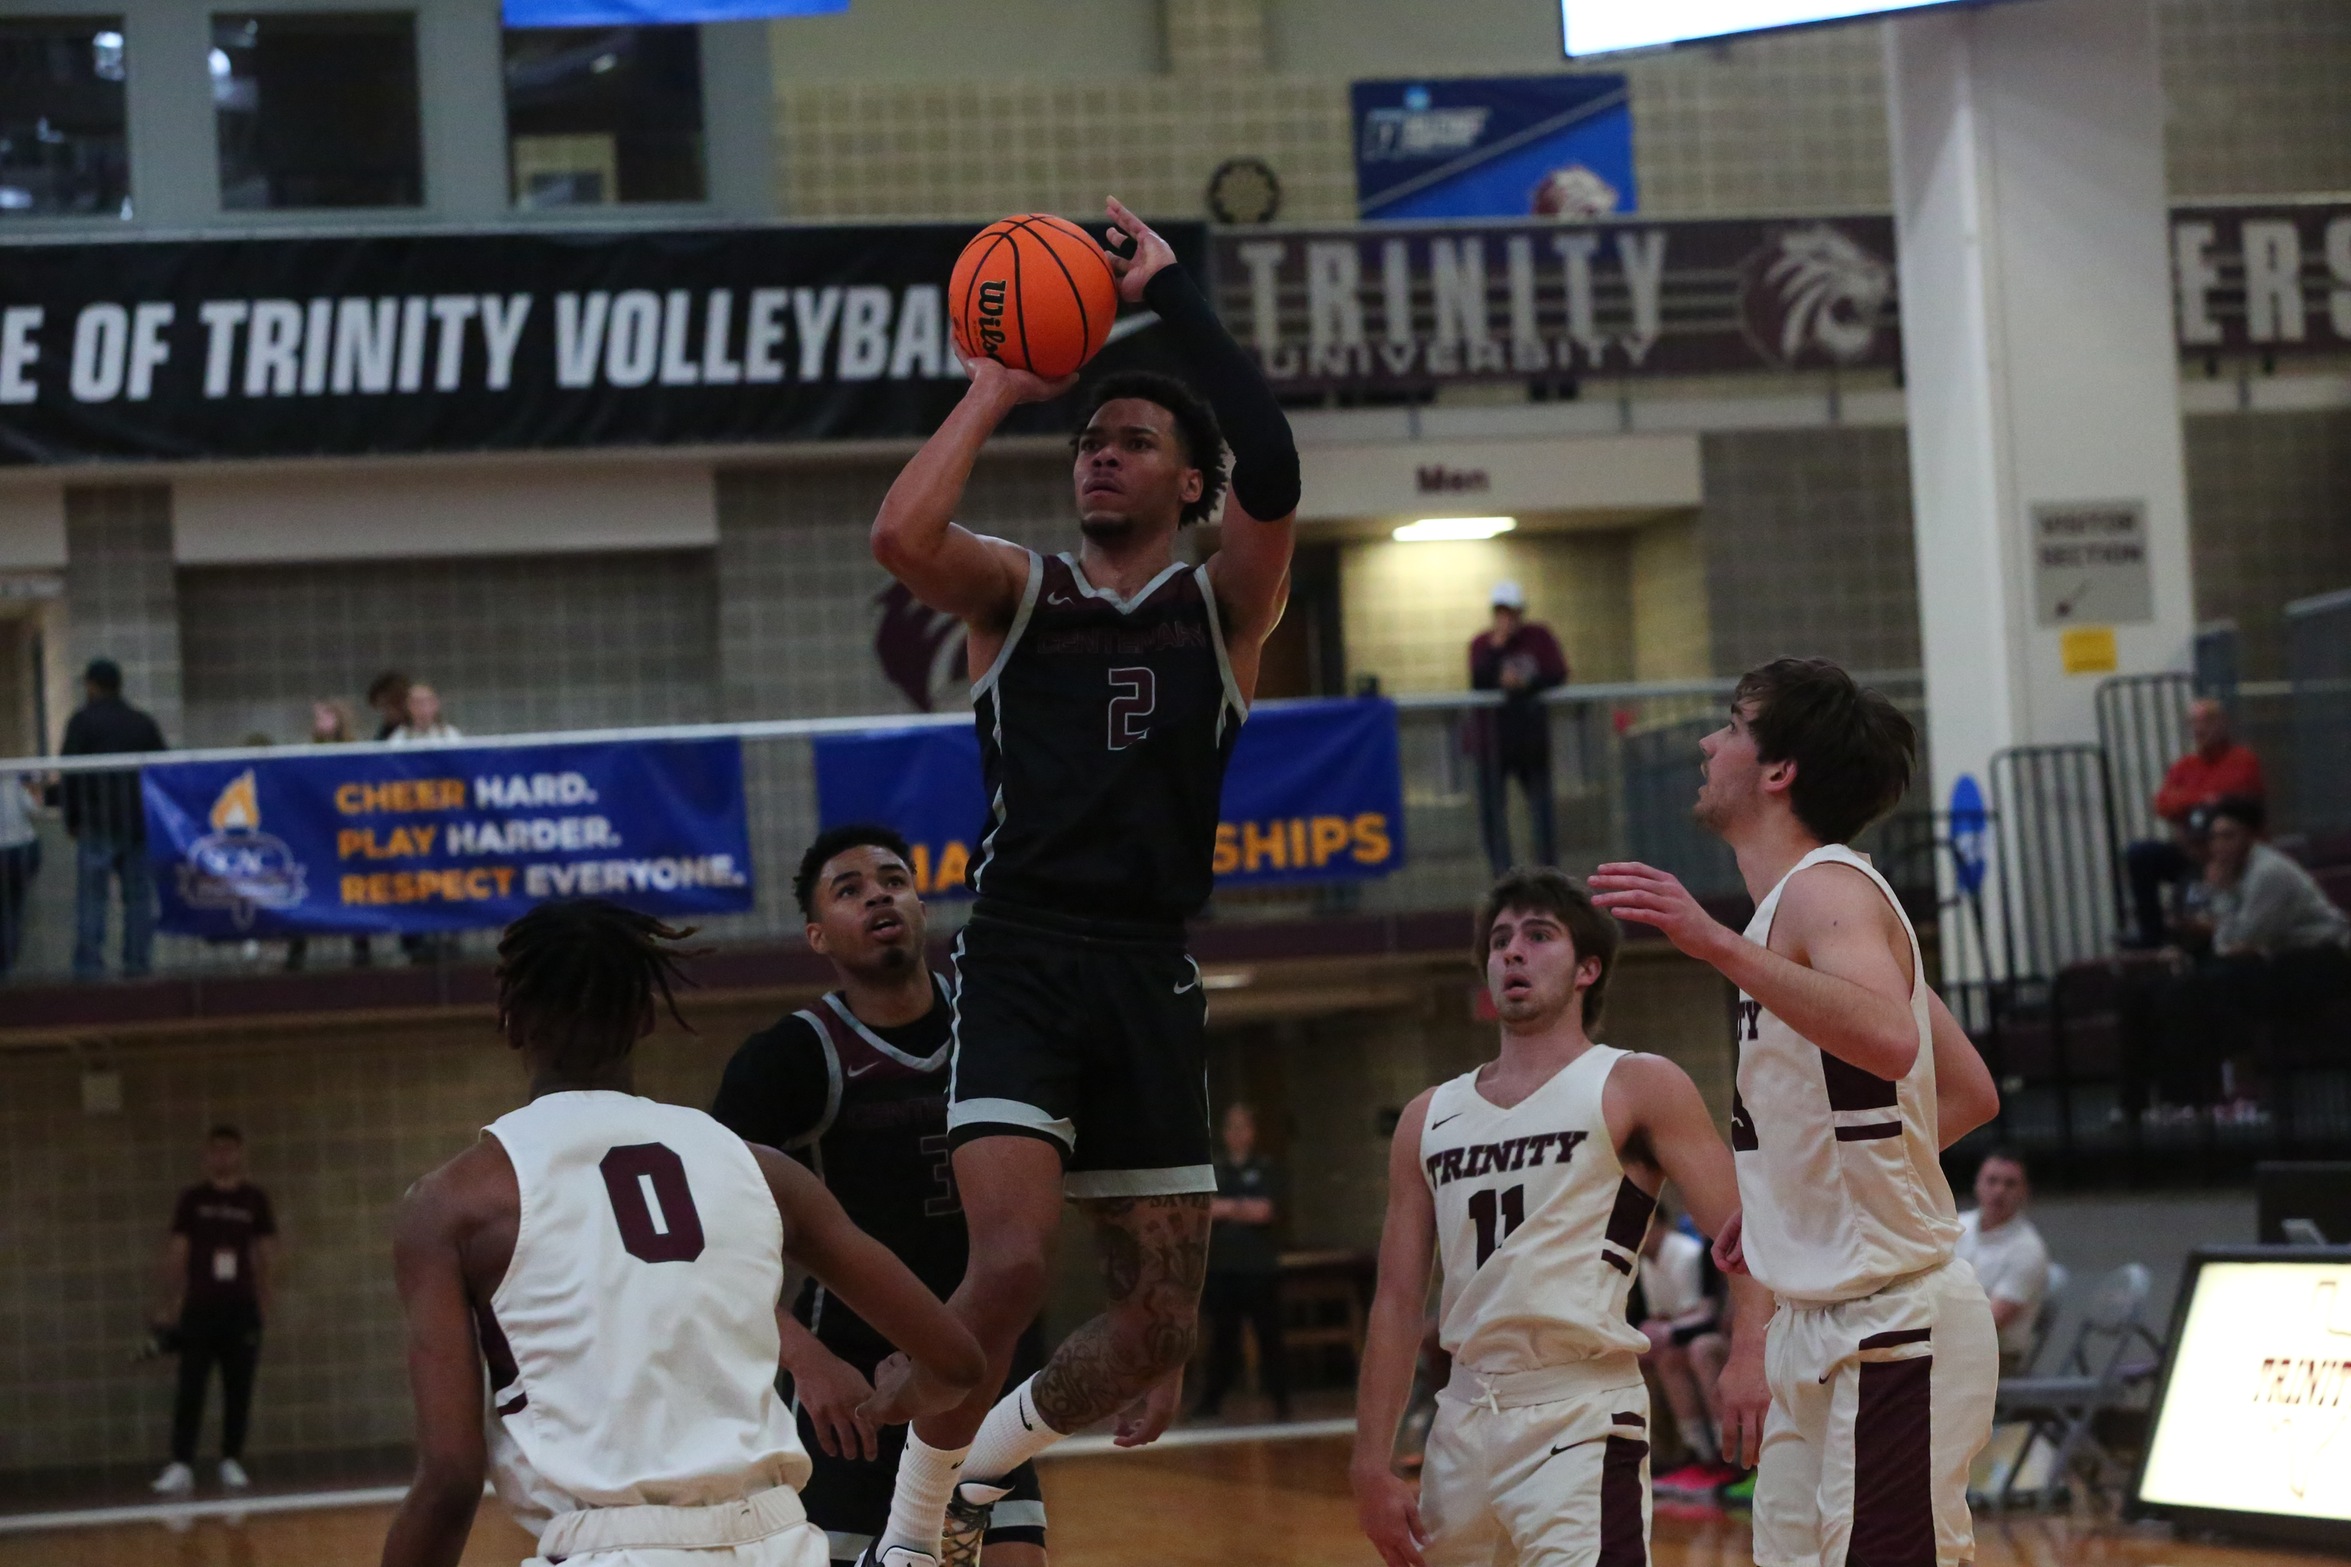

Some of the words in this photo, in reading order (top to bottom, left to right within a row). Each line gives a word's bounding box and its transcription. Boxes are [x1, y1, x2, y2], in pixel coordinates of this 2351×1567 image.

[1238, 231, 1668, 345] TRINITY
[70, 302, 175, 402] OF
[199, 294, 533, 397] TRINITY
[1261, 333, 1662, 378] UNIVERSITY
[1108, 666, 1156, 751] 2
[335, 777, 465, 815] CHEER
[474, 771, 599, 809] HARD.
[337, 826, 438, 861] PLAY
[446, 815, 623, 857] HARDER.
[340, 867, 515, 906] RESPECT
[524, 853, 748, 899] EVERYONE.
[1426, 1130, 1590, 1190] TRINITY
[599, 1142, 705, 1264] 0
[1468, 1184, 1526, 1270] 11
